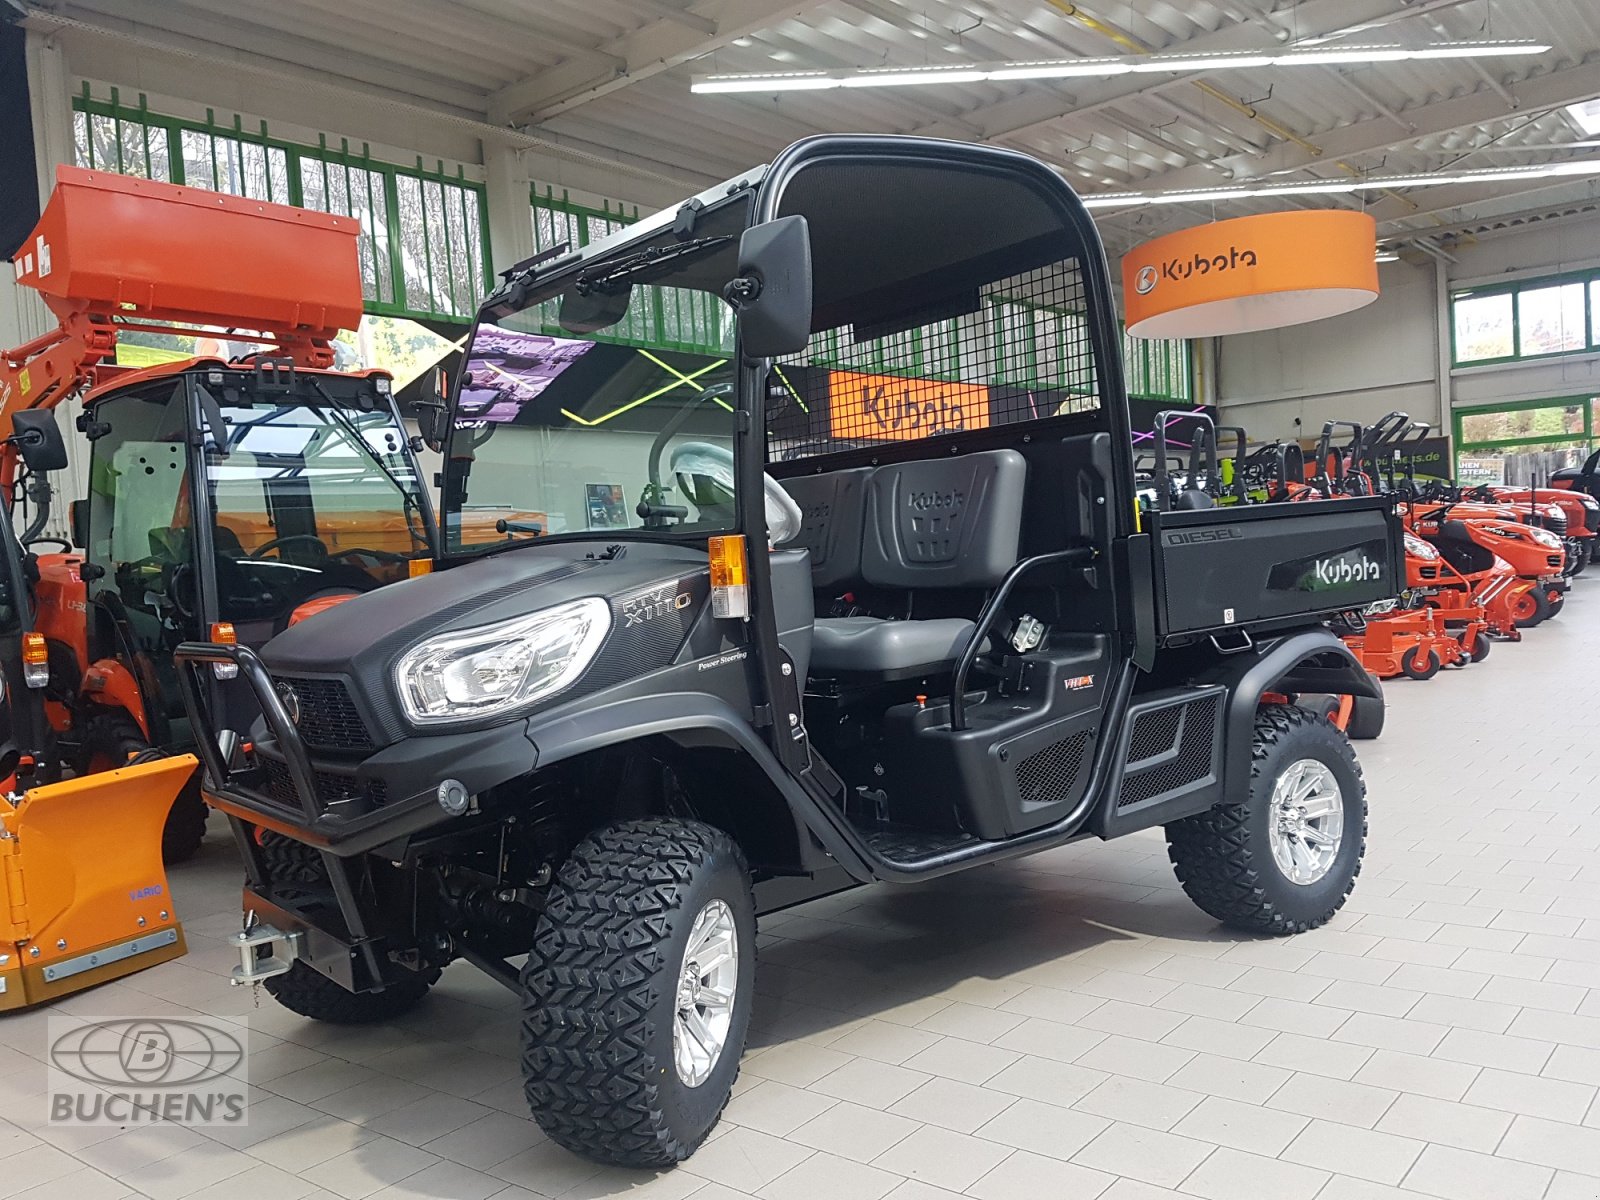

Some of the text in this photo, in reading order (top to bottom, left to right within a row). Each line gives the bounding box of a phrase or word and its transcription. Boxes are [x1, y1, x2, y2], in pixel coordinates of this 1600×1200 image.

[1163, 246, 1257, 280] Kubota
[862, 385, 965, 431] Kubota
[1167, 528, 1243, 545] DIESEL
[1316, 555, 1380, 584] Kubota
[698, 651, 748, 671] Power Steering
[129, 884, 163, 902] VARIO
